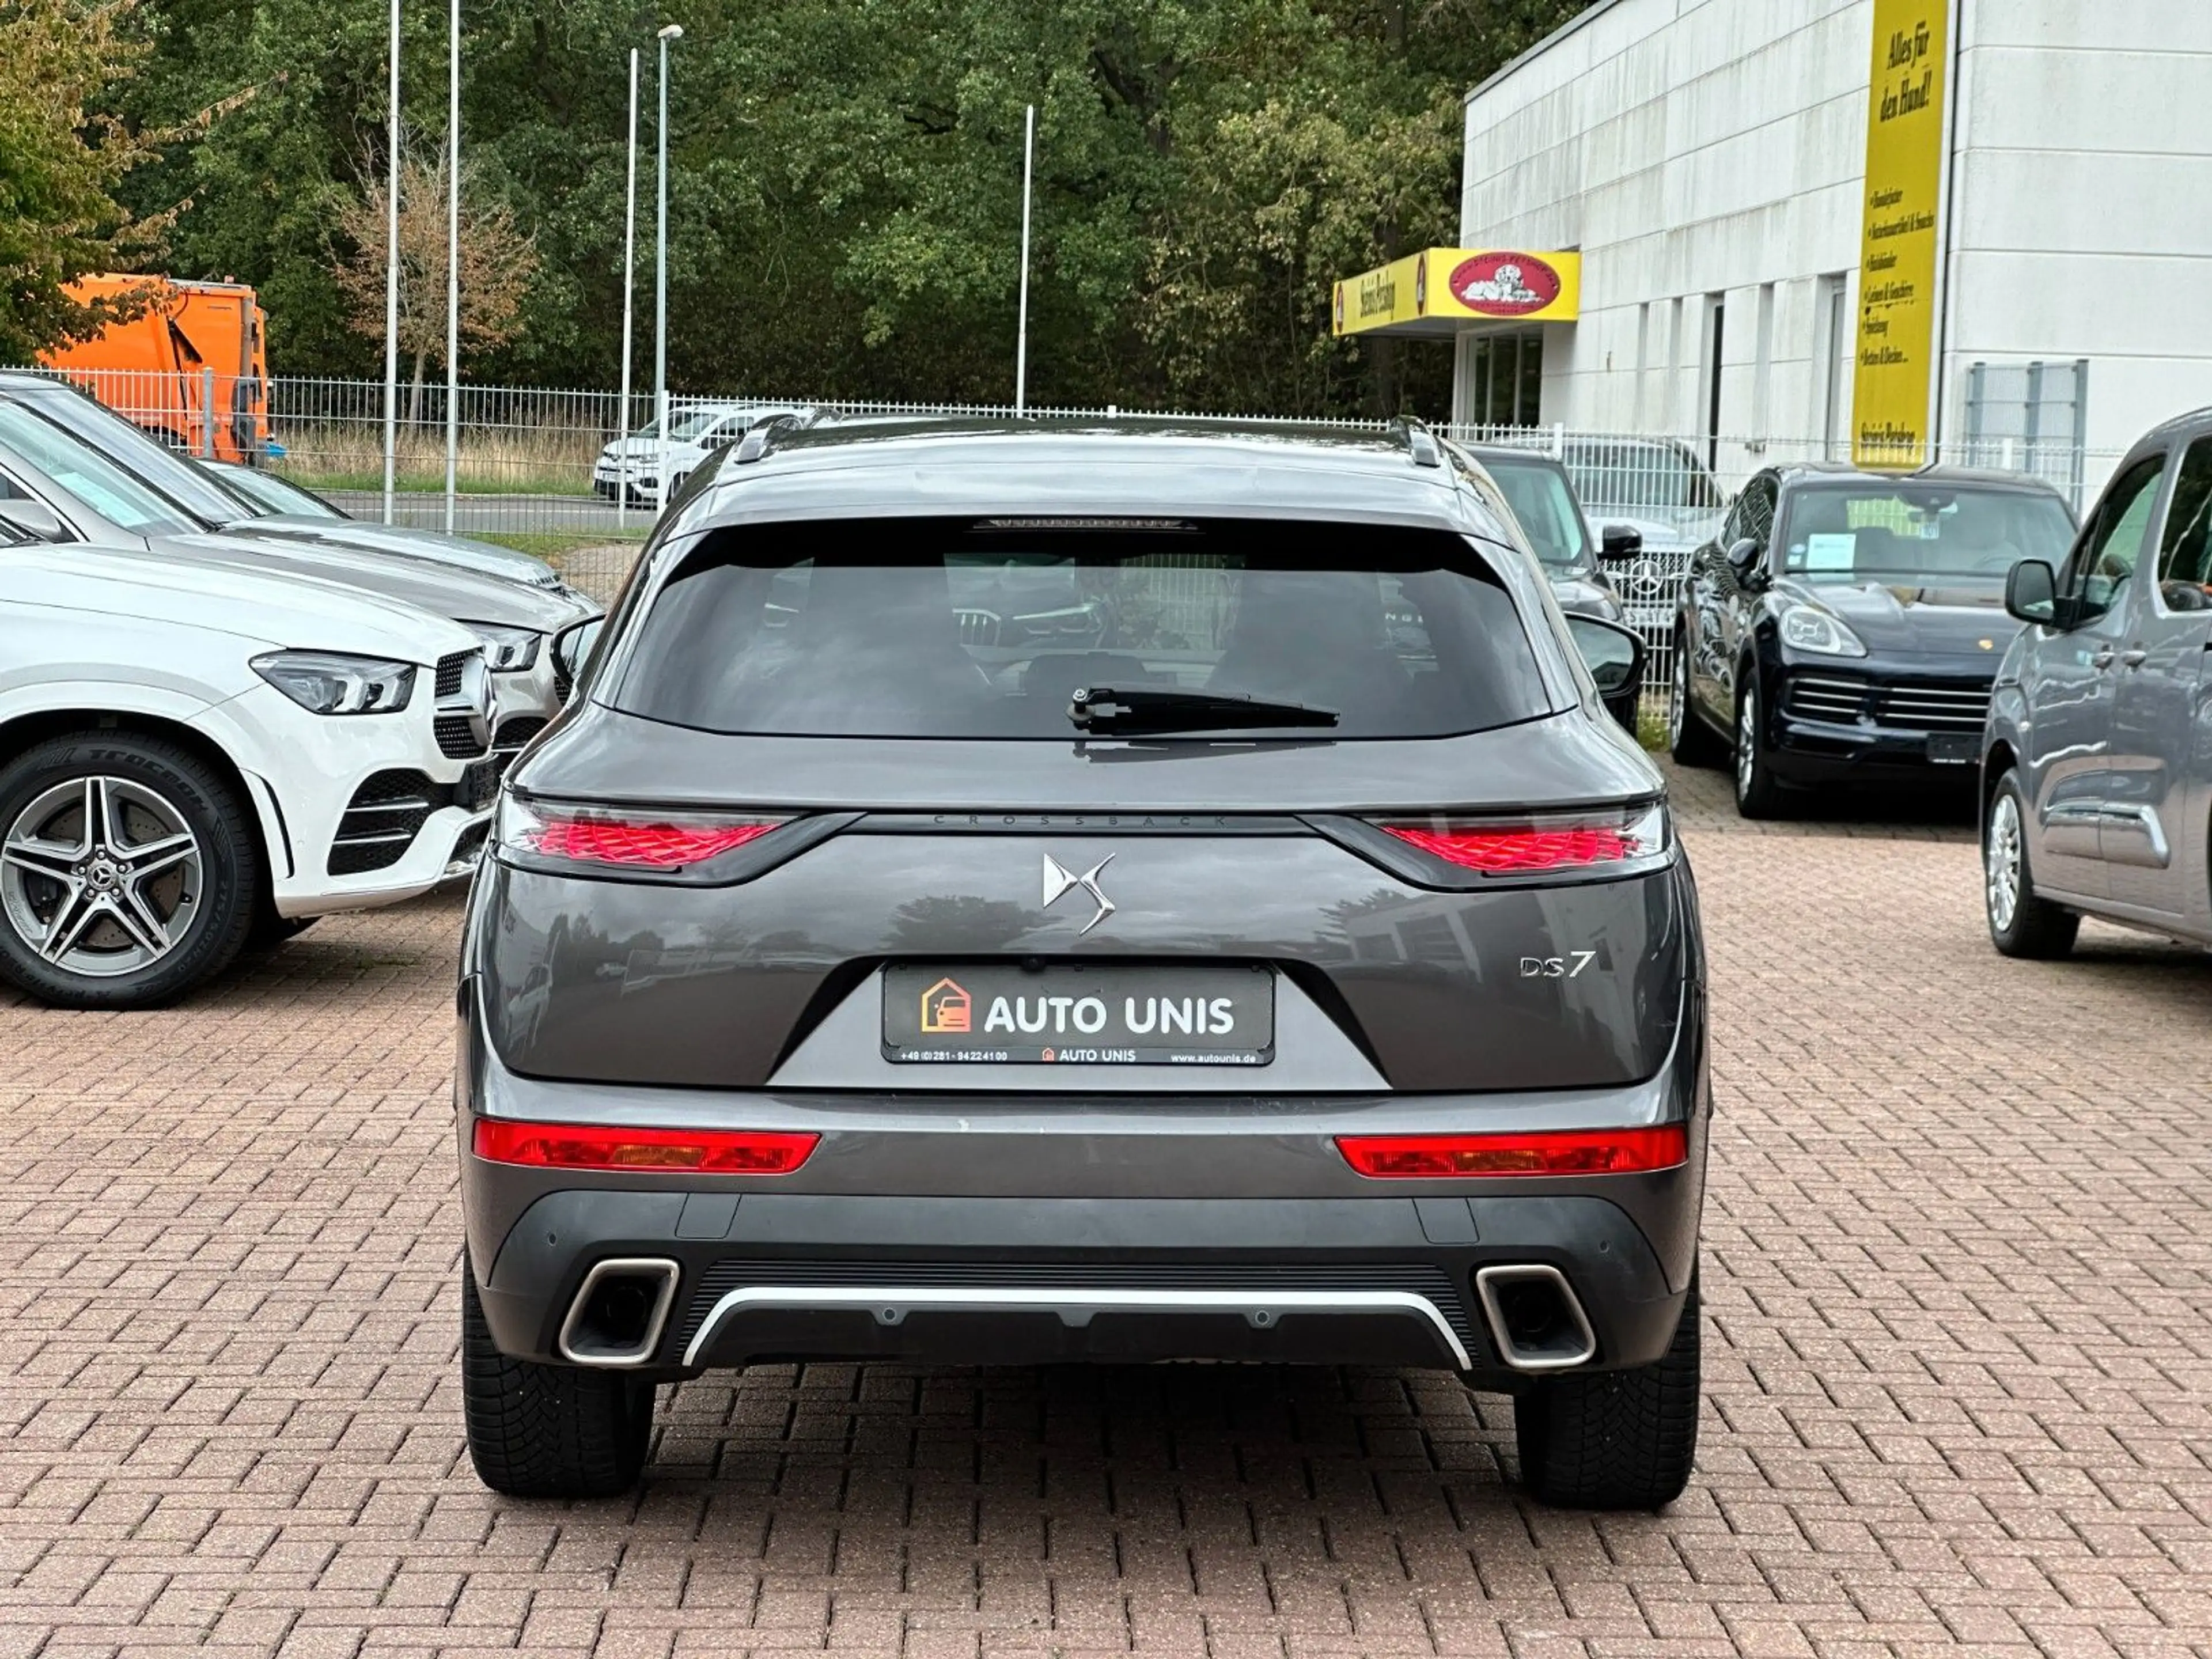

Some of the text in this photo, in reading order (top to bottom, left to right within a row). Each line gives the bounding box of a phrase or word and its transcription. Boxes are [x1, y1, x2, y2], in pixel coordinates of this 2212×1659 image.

[1887, 30, 1912, 70] Alles
[1880, 70, 1932, 122] den Hund!
[934, 815, 1225, 826] CROSSBACK
[984, 996, 1234, 1035] AUTO UNIS
[1059, 1049, 1136, 1062] AUTO UNIS
[1171, 1053, 1256, 1063] www.autounis.de
